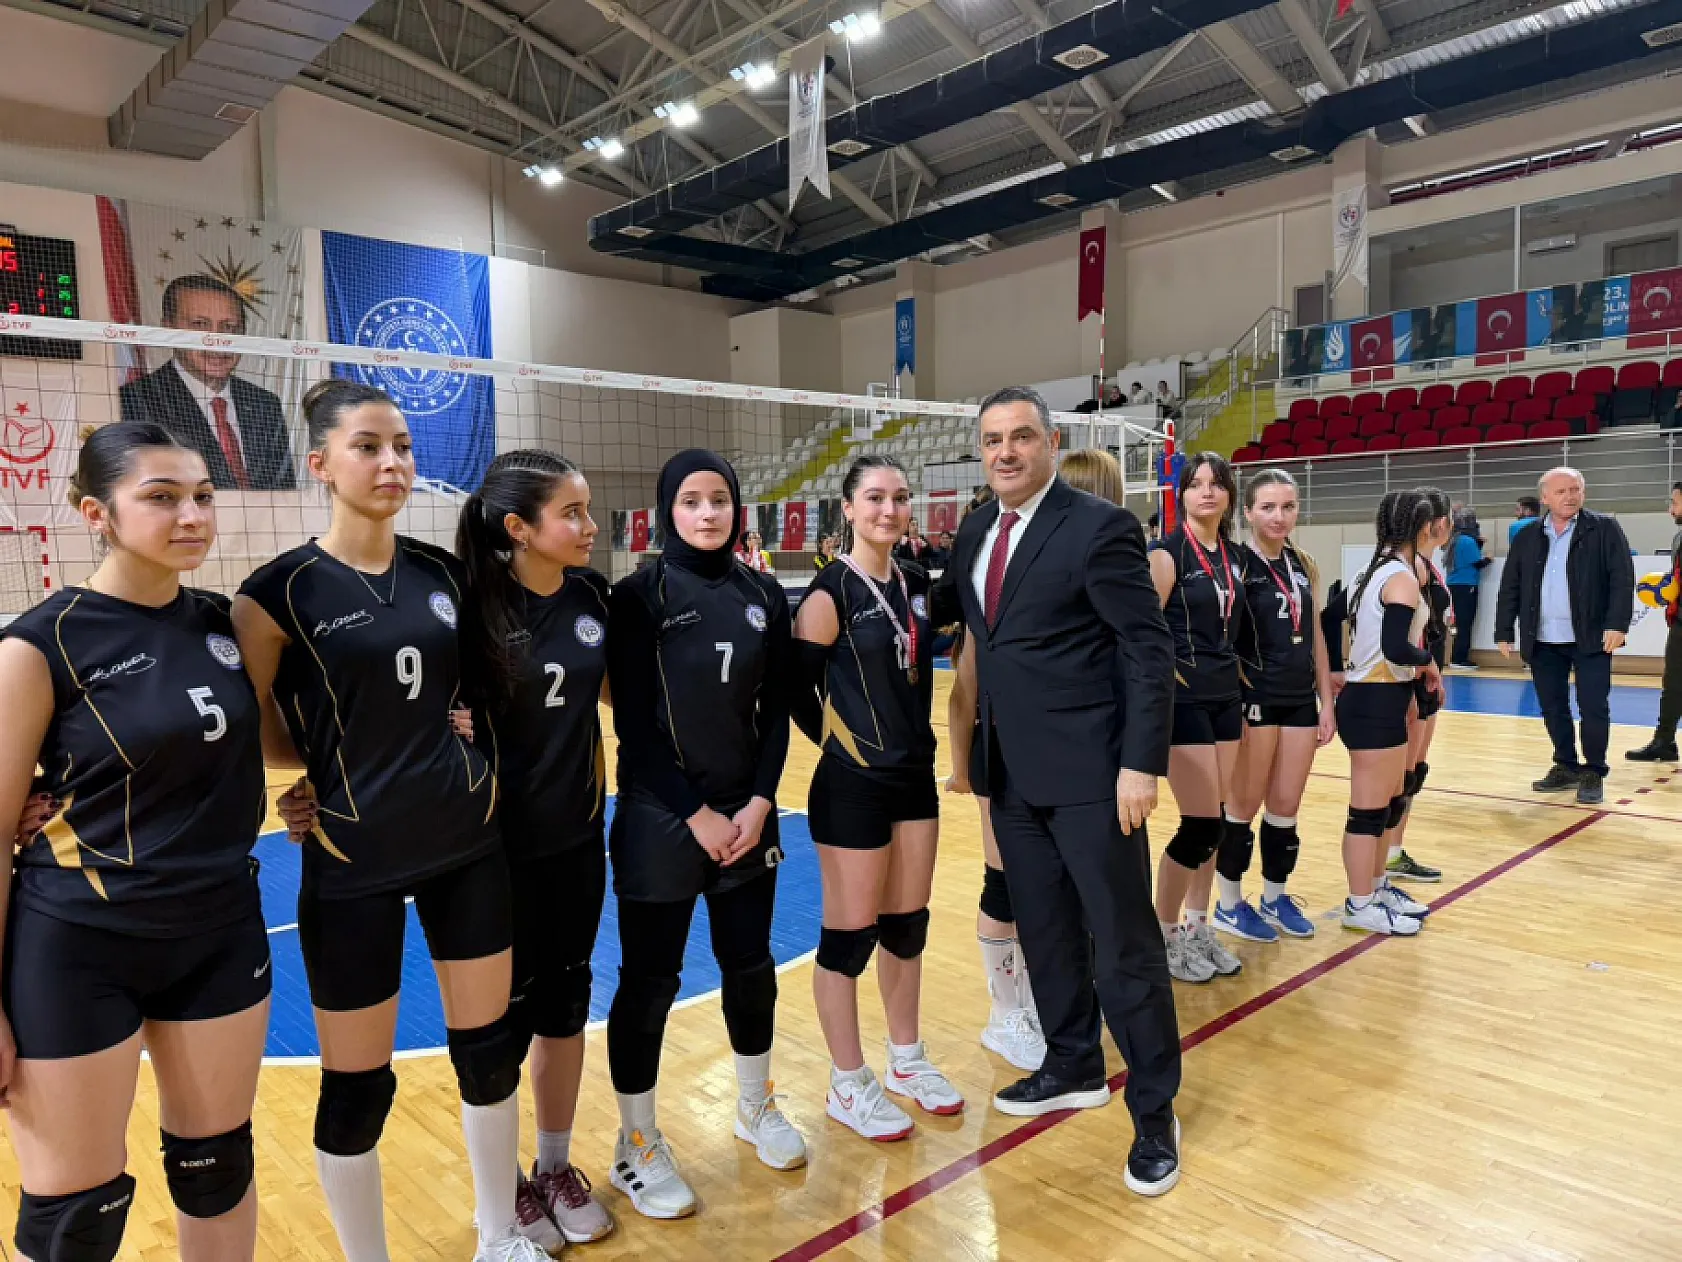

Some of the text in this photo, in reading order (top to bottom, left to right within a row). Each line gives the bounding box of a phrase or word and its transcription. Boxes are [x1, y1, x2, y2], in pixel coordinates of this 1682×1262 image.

[0, 466, 51, 490] TVF
[395, 645, 423, 700] 9
[543, 662, 566, 708] 2
[715, 641, 734, 684] 7
[186, 685, 228, 742] 5
